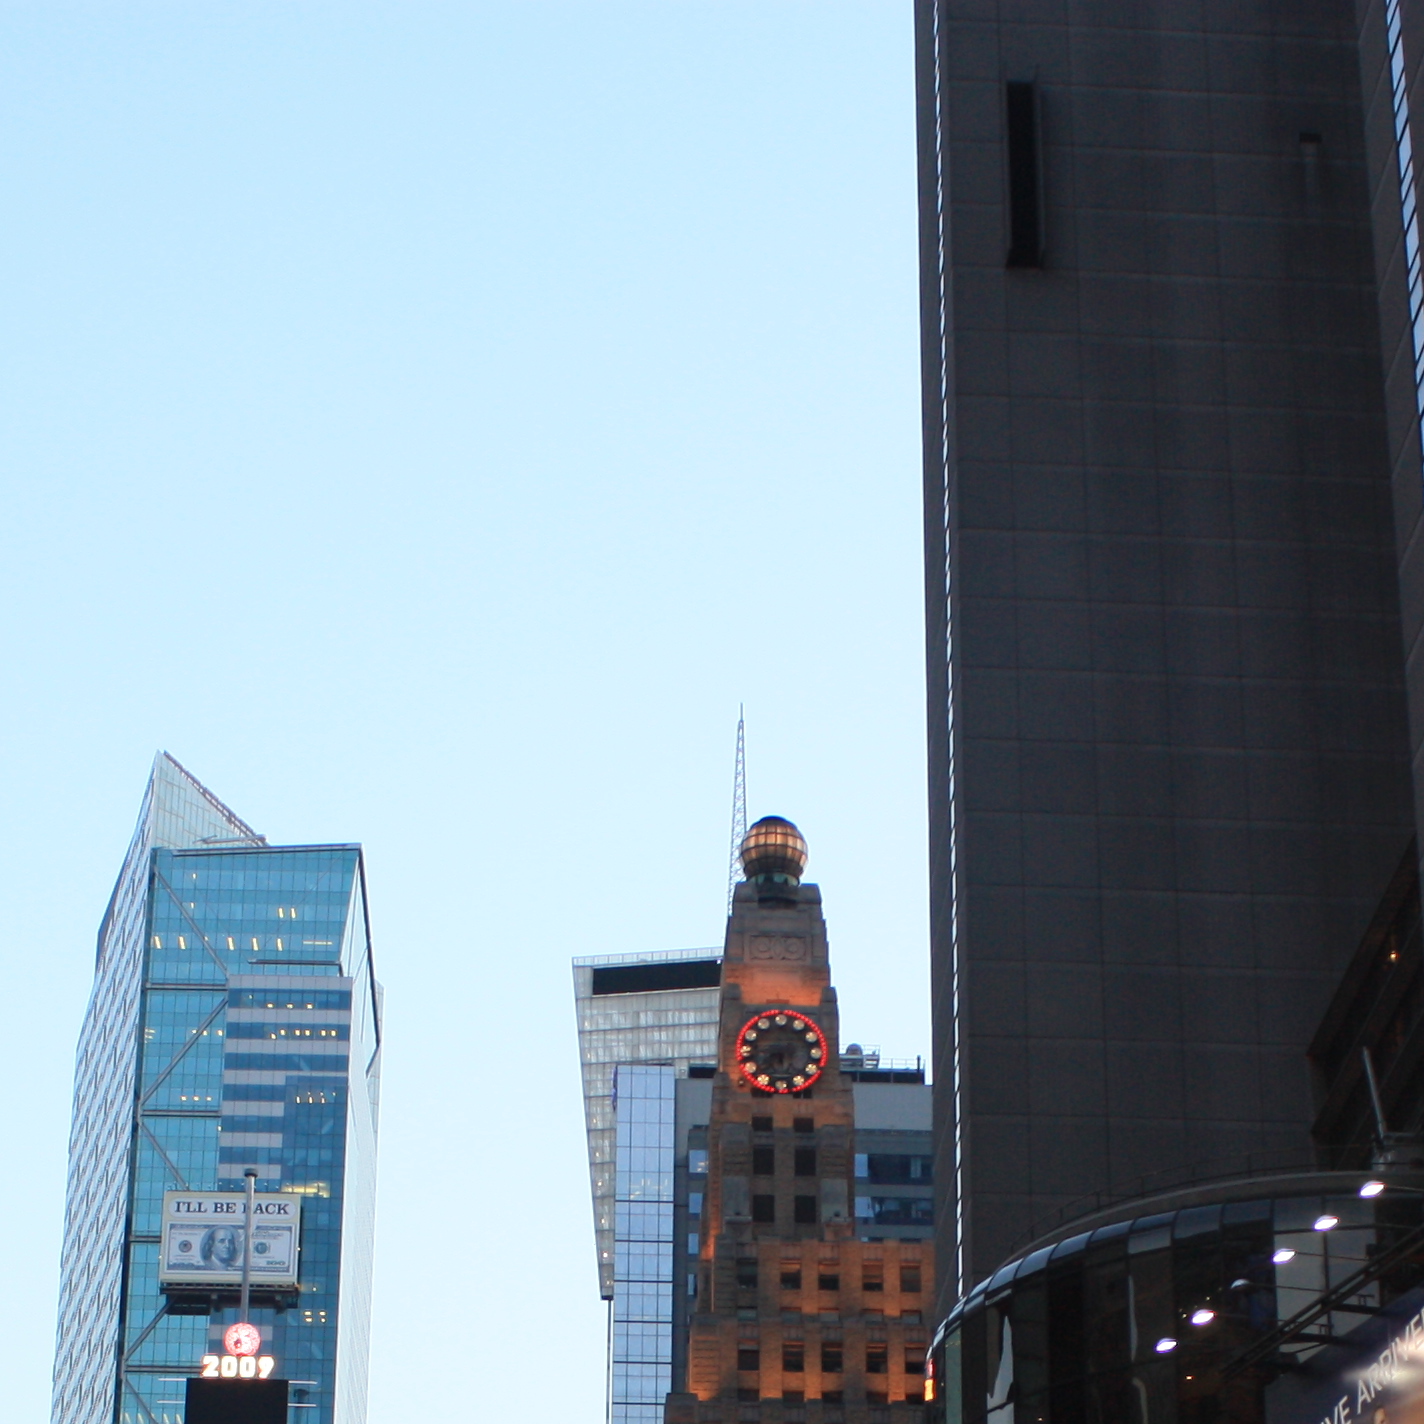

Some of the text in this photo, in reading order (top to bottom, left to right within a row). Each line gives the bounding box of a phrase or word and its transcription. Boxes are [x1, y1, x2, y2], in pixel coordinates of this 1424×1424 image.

[175, 1201, 289, 1214] I'LL BE ACK
[202, 1355, 275, 1378] 2009
